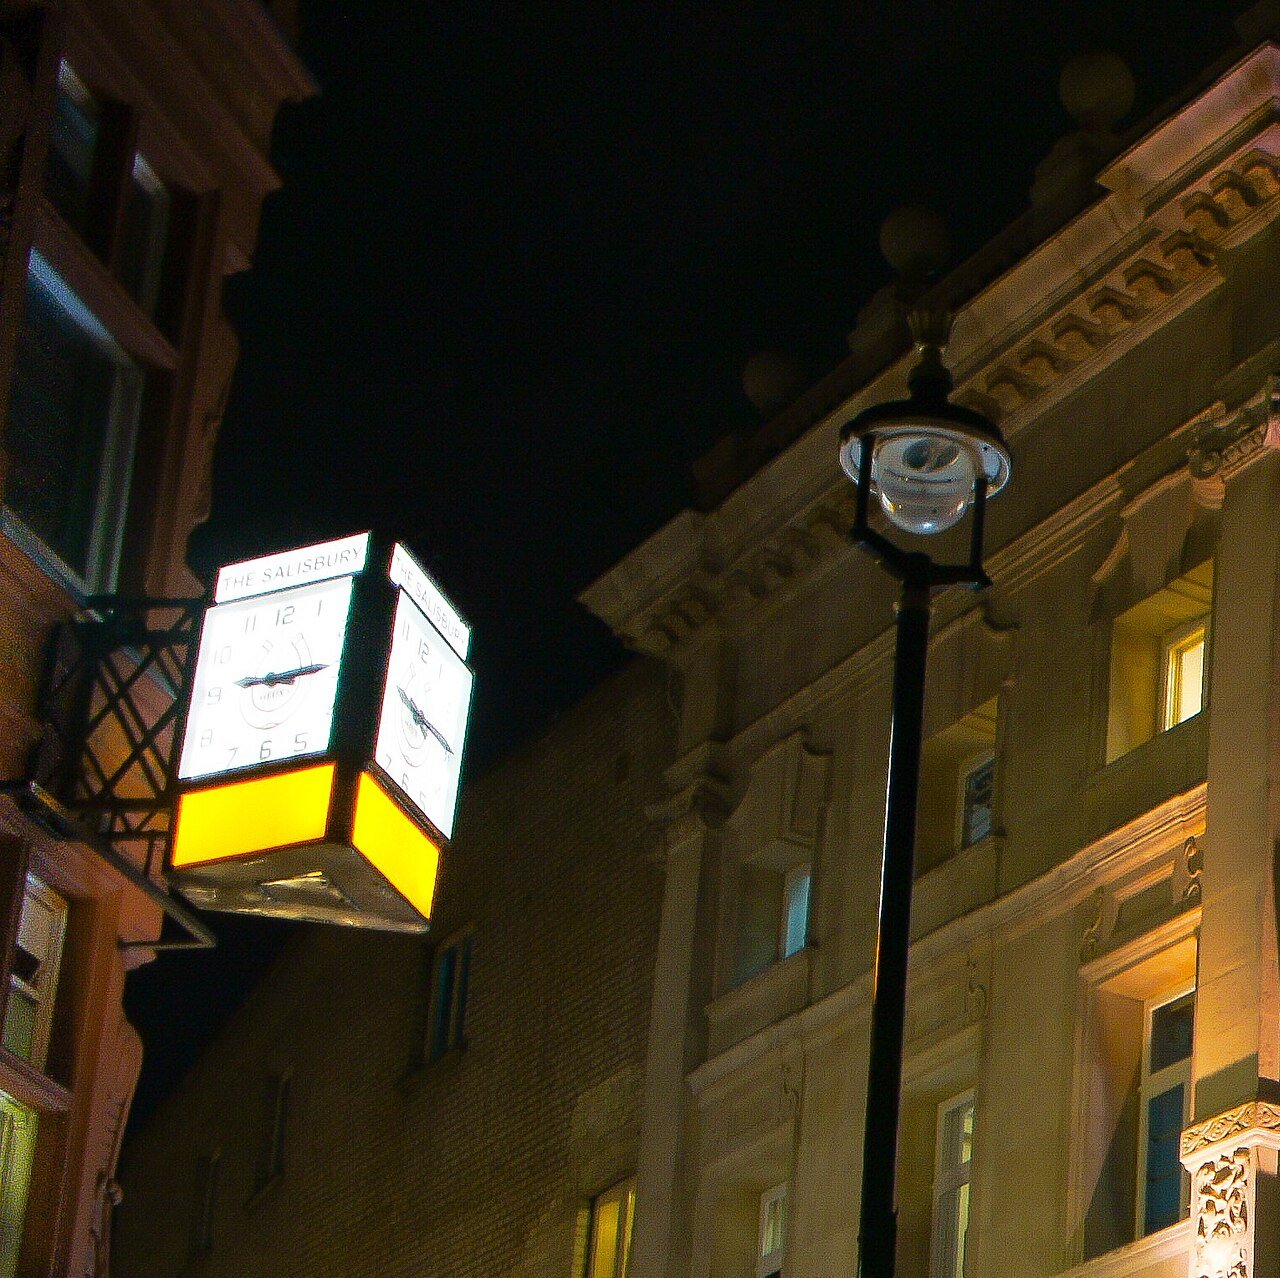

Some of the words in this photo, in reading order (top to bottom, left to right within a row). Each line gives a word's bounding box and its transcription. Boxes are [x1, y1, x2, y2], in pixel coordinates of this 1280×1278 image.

[224, 570, 258, 591] THE
[262, 546, 363, 582] SALISBURY
[245, 615, 257, 633] 11
[276, 605, 296, 628] 12
[415, 583, 465, 645] SALISBURY
[417, 638, 430, 664] 12
[207, 687, 222, 706] 9
[260, 740, 272, 761] 6
[294, 732, 309, 753] 5
[226, 747, 239, 768] 7
